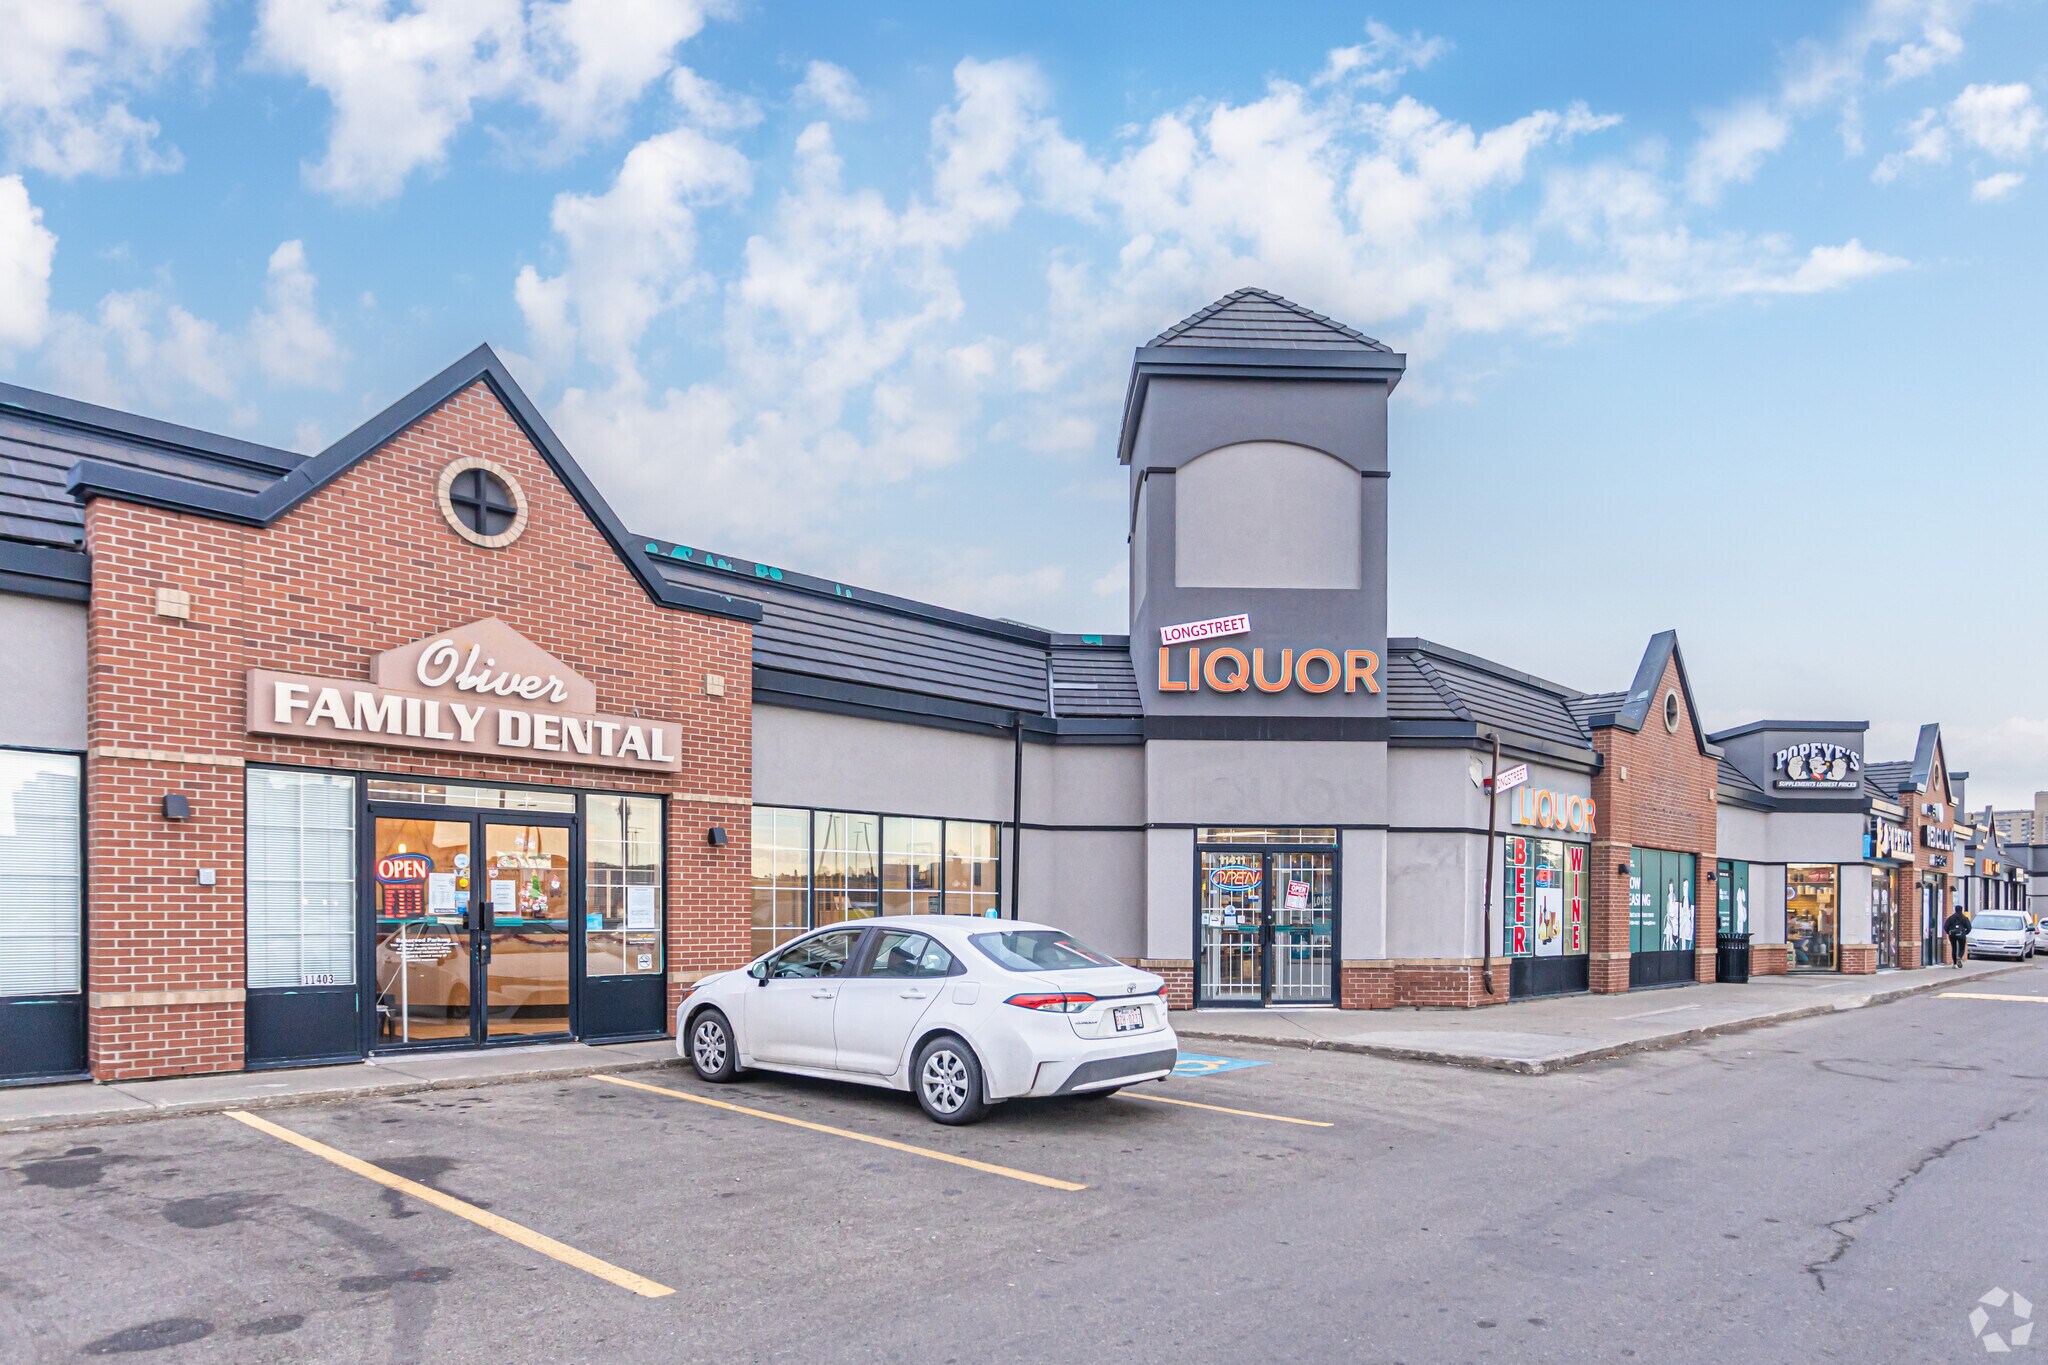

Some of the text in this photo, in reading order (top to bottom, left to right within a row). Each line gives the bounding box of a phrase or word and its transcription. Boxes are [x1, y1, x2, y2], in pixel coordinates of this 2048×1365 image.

[1164, 617, 1246, 641] LONGSTREET
[416, 638, 568, 703] Oliver
[1158, 647, 1381, 693] LIQUOR
[274, 681, 675, 763] FAMILY DENTAL
[1497, 767, 1525, 789] ONGSTREET
[1518, 785, 1597, 834] LIQUOR
[378, 859, 426, 878] OPEN
[1219, 854, 1246, 864] 11411
[1213, 871, 1260, 884] OPEN
[1291, 884, 1306, 893] OPEN
[1630, 876, 1641, 889] OW
[1514, 837, 1527, 955] BEER
[1570, 847, 1584, 950] WINE
[305, 974, 334, 984] 11403
